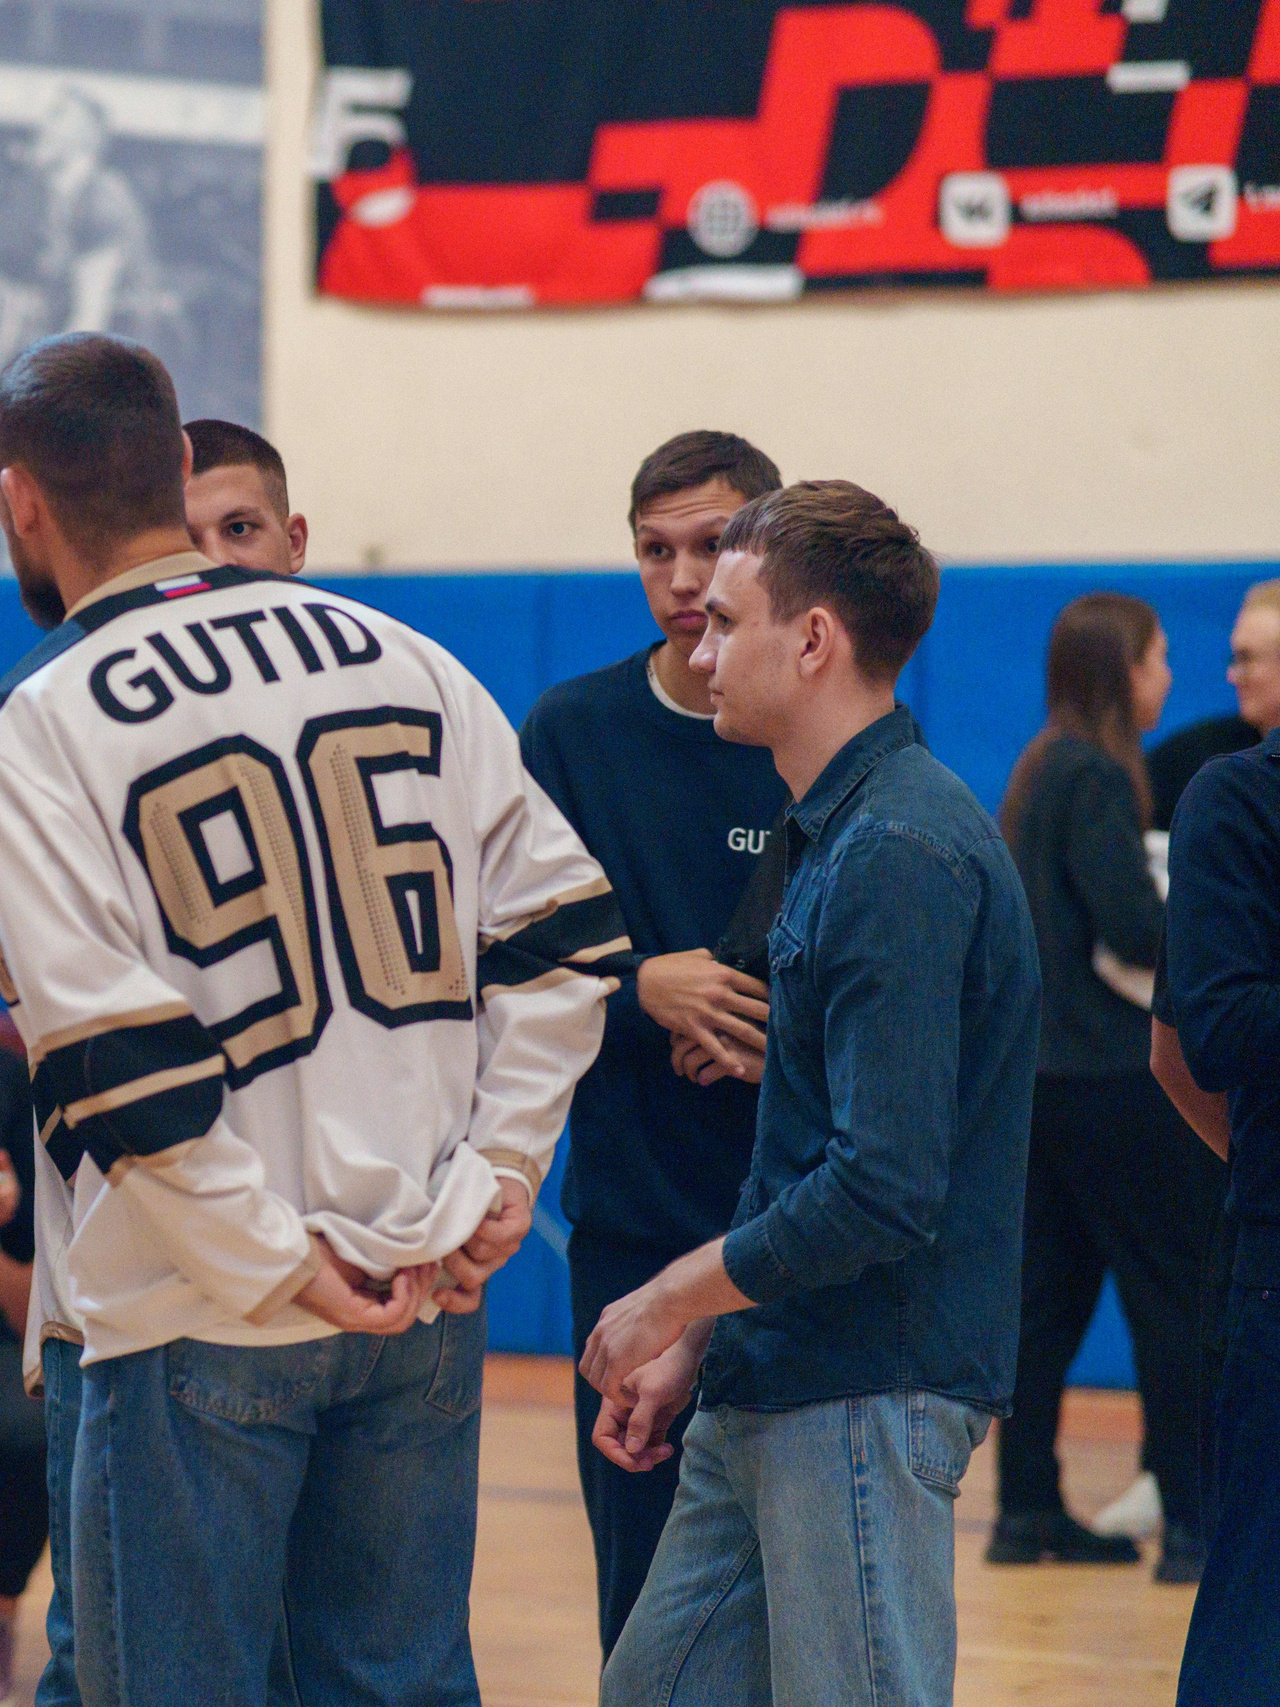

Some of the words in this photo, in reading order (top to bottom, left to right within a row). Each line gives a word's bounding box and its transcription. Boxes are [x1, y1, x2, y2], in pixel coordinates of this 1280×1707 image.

[87, 602, 383, 724] GUTID
[122, 705, 474, 1092] 96
[727, 827, 771, 854] GU
